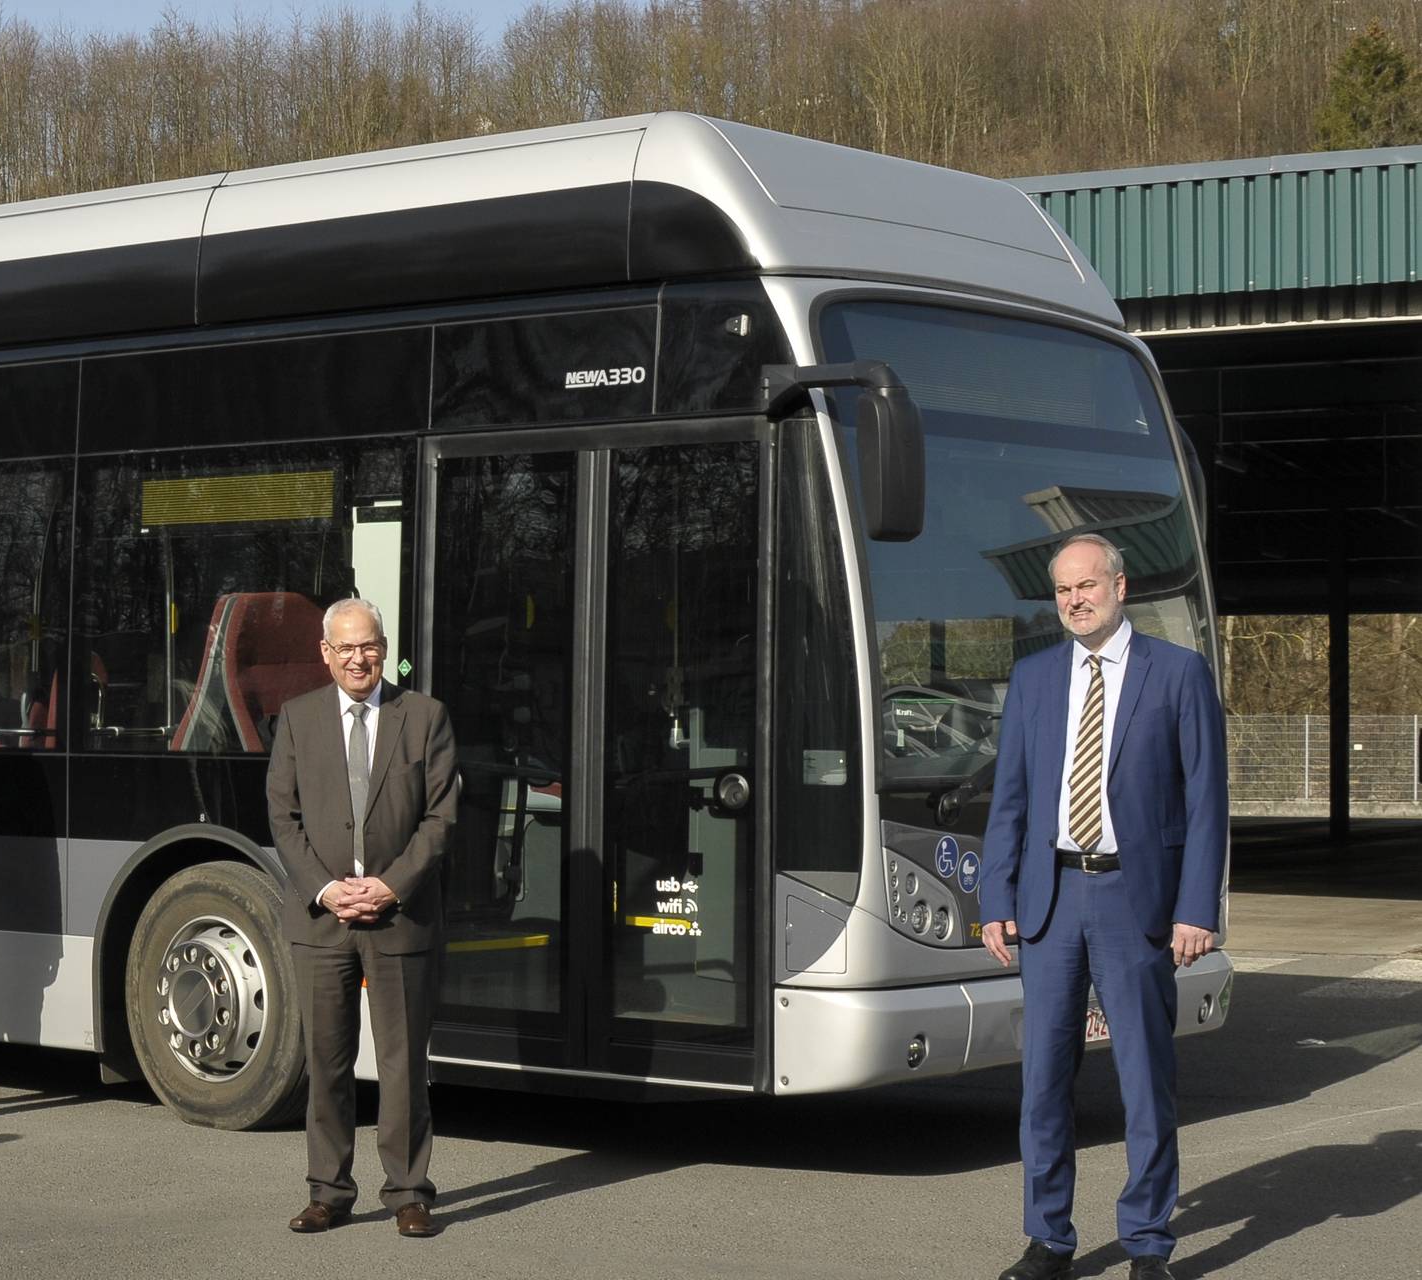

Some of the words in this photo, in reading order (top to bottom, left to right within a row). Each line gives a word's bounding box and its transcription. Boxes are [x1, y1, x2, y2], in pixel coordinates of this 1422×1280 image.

[656, 876, 680, 892] usb
[656, 898, 683, 914] wifi
[652, 918, 687, 936] airco
